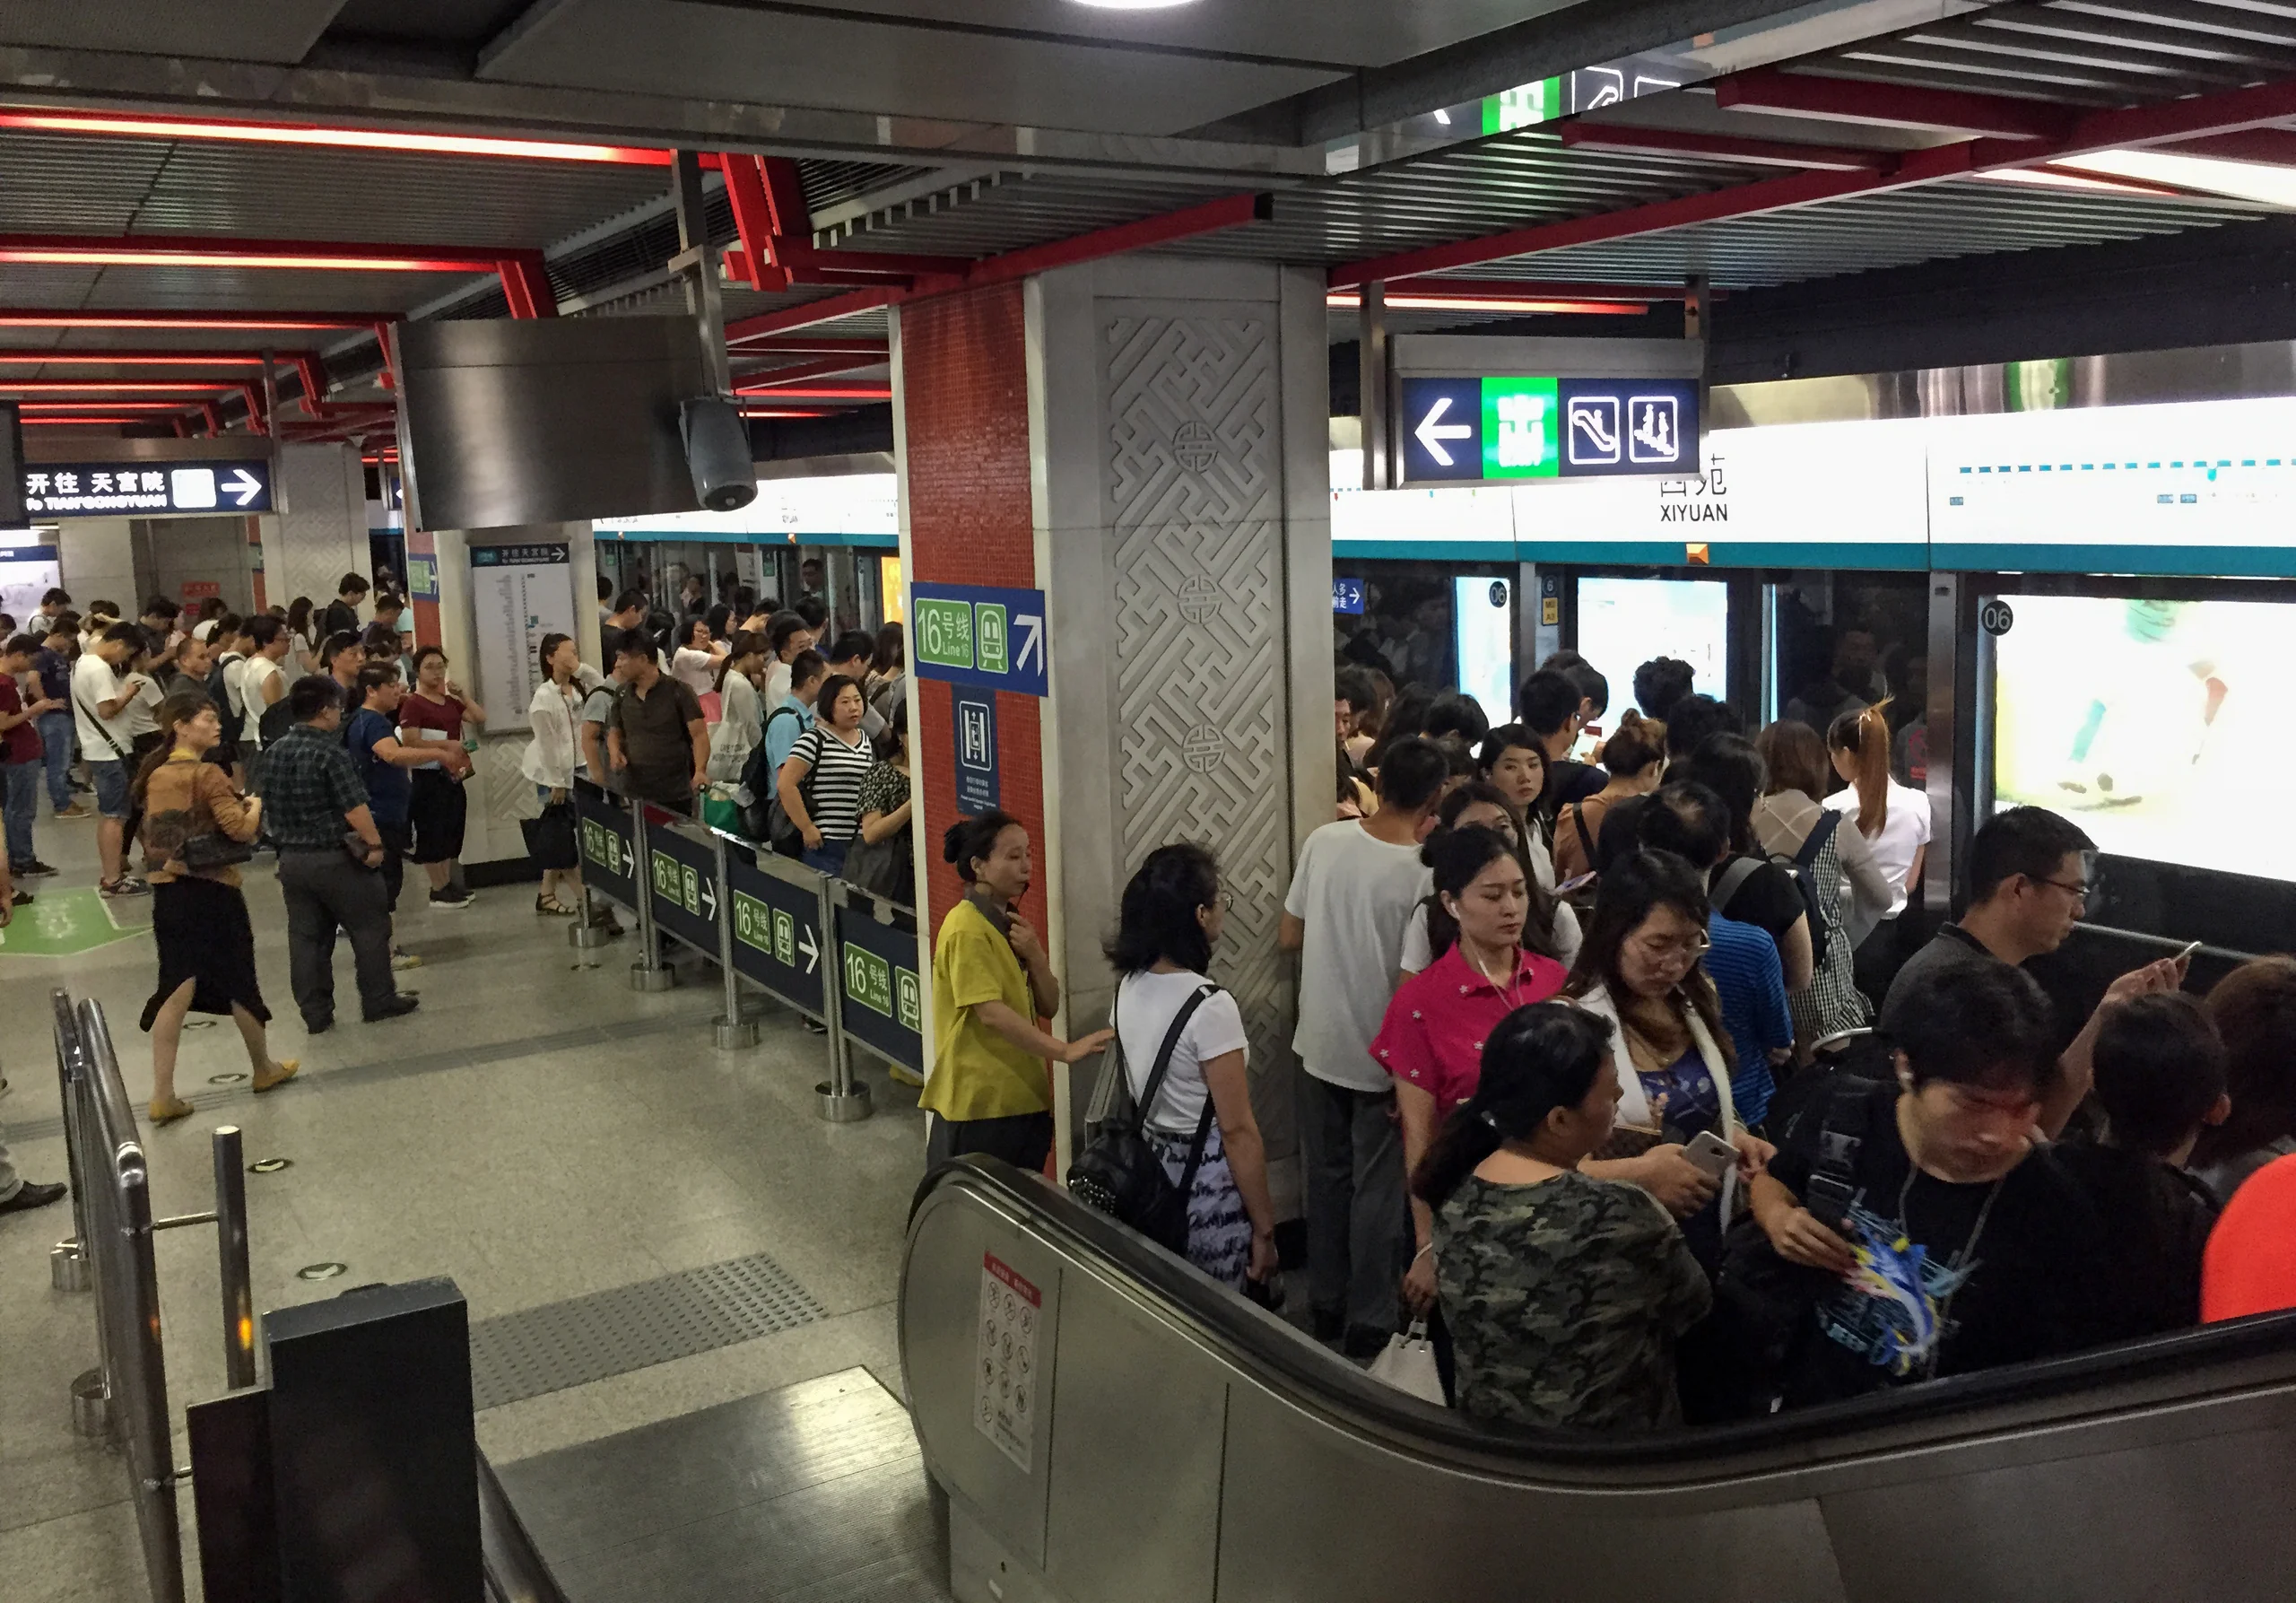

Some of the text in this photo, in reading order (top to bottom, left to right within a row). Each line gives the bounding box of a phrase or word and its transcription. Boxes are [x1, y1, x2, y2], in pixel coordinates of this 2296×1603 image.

[26, 471, 165, 494] 开往 天宫院
[1660, 503, 1727, 522] XIYUAN
[1490, 586, 1506, 603] 06
[1985, 607, 2011, 630] 06
[918, 607, 970, 655] 16 号线
[943, 641, 961, 658] Line
[654, 858, 666, 890] 16
[736, 900, 752, 936] 16
[847, 953, 867, 994] 16
